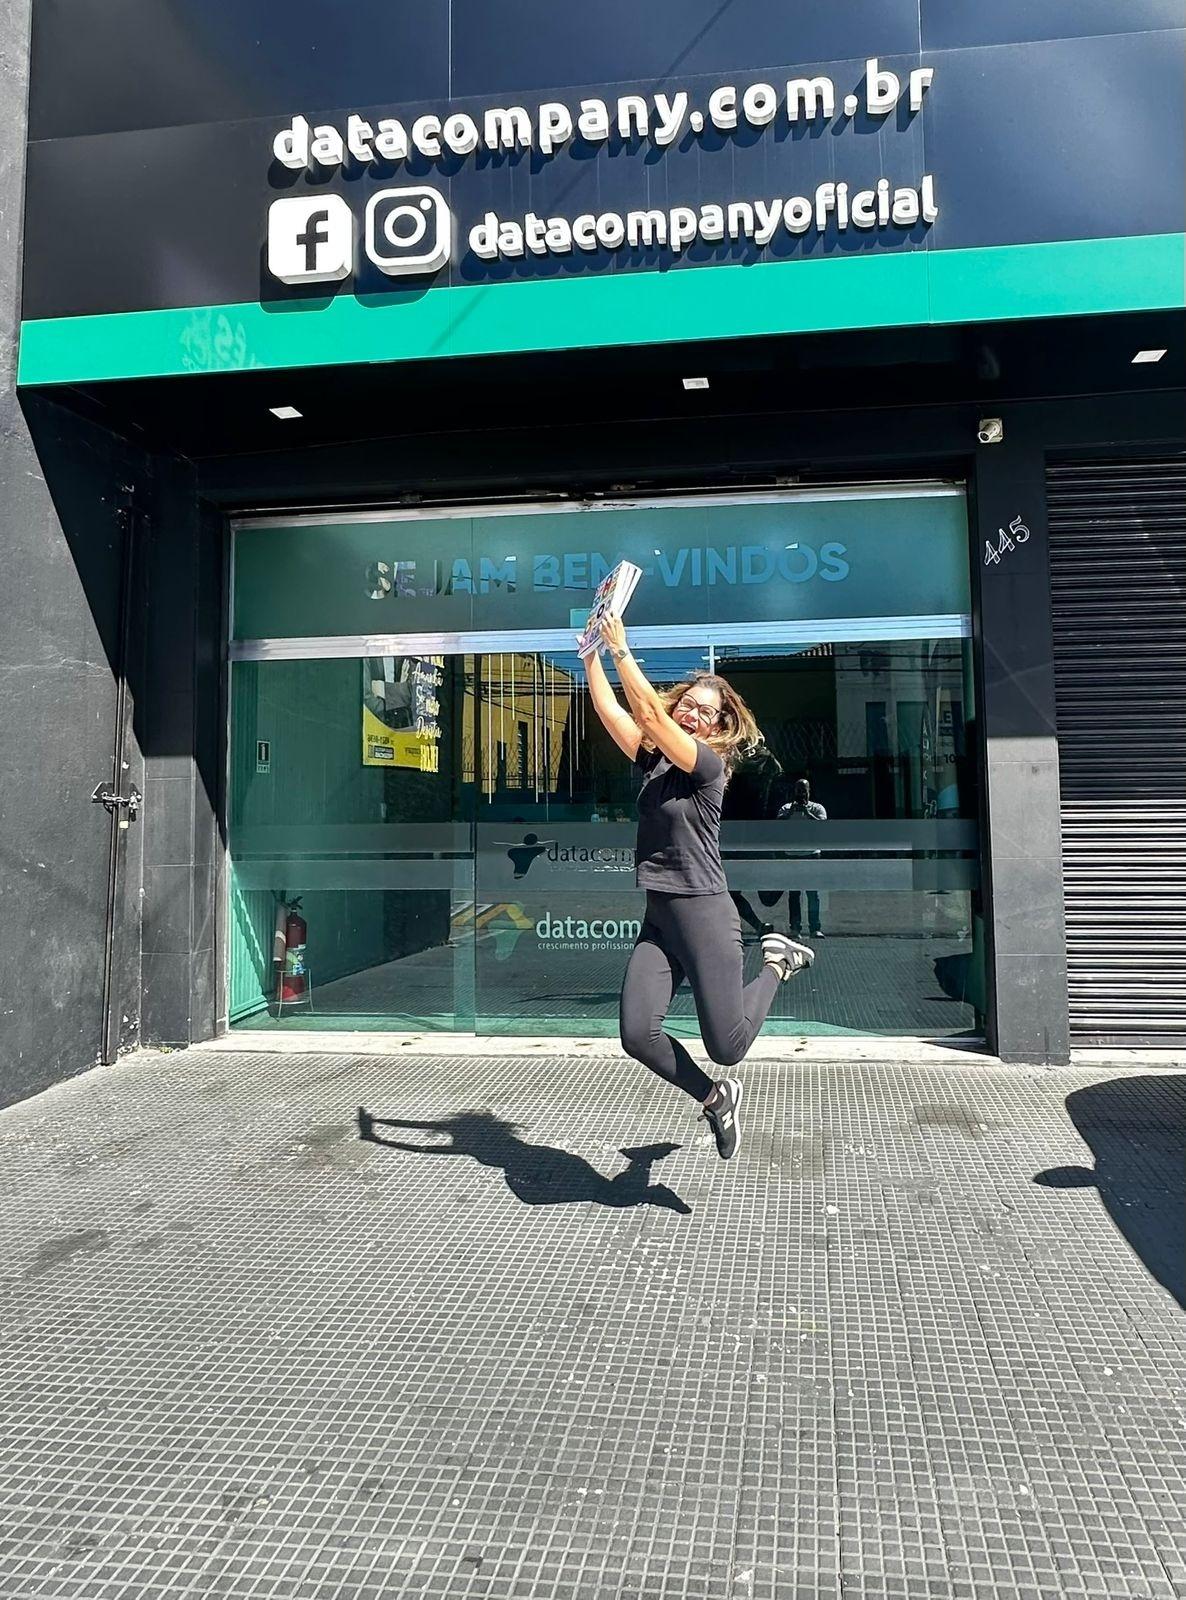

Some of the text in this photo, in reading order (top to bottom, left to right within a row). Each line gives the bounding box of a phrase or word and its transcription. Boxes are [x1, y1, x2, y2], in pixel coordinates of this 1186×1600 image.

[272, 57, 934, 171] datacompany.com.br
[468, 174, 938, 260] datacompanyoficial
[984, 514, 1030, 566] 445
[365, 556, 519, 600] SEJAM
[536, 911, 641, 939] datacom
[537, 941, 589, 950] crescimento
